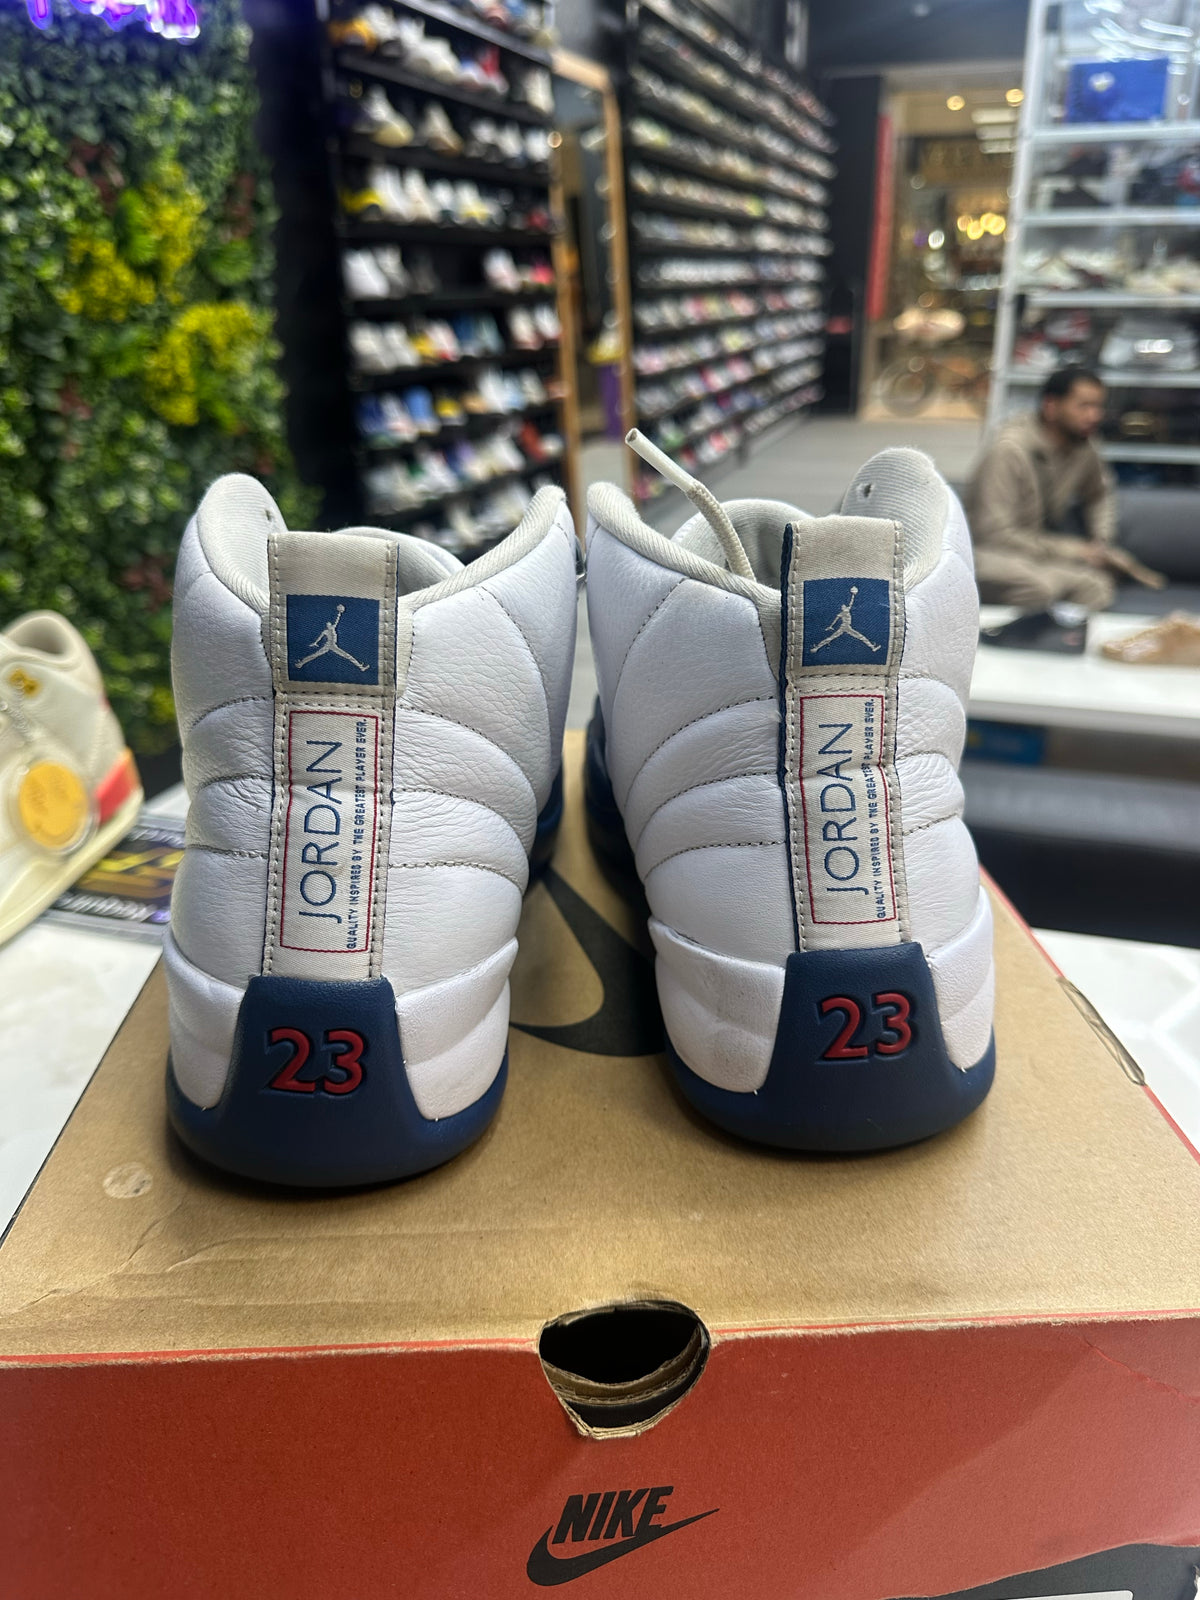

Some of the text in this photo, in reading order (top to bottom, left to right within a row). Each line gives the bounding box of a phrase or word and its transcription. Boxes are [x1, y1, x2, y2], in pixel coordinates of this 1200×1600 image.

[863, 726, 875, 761] PLAYER
[299, 739, 344, 924] JORDAN
[346, 718, 368, 949] QUALITY INSPIRED BY THE GREATEST PLAYER EVER.
[817, 722, 869, 896] JORDAN
[868, 801, 879, 818] THE
[869, 822, 880, 834] BY
[870, 836, 881, 877] INSPIRED
[873, 879, 886, 919] QUALITY
[820, 991, 913, 1059] 23
[269, 1026, 365, 1095] 23
[551, 1485, 675, 1546] NIKE
